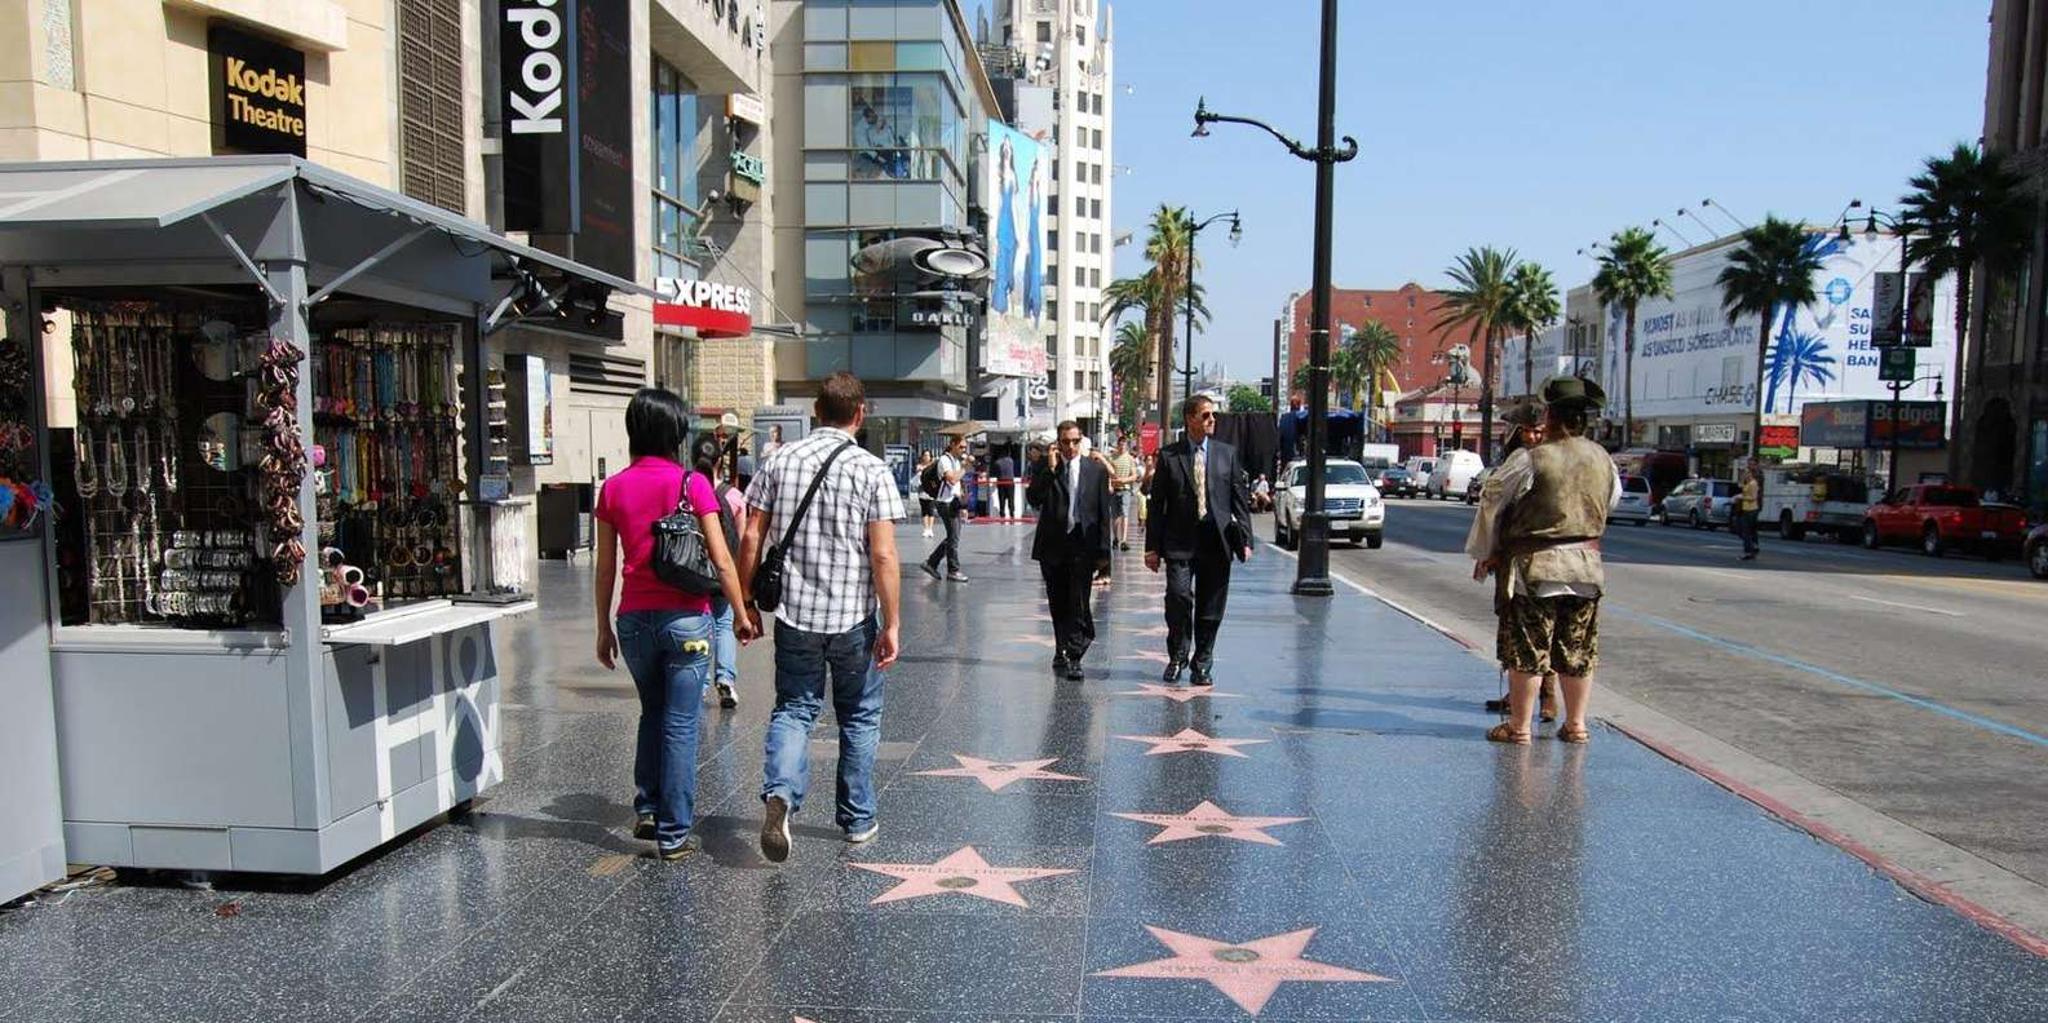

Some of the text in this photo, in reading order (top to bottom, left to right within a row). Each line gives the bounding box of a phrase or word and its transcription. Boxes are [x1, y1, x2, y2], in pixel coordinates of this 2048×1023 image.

[697, 0, 752, 49] ORA
[507, 0, 563, 133] Kod
[227, 57, 304, 106] Kodak
[228, 93, 304, 136] Theatre
[656, 277, 751, 315] EXPRESS
[1850, 308, 1871, 319] SA
[1849, 324, 1869, 335] SU
[1847, 355, 1879, 367] BAN
[1705, 385, 1744, 405] CHASE
[882, 866, 1039, 876] CHARLIZE THERON
